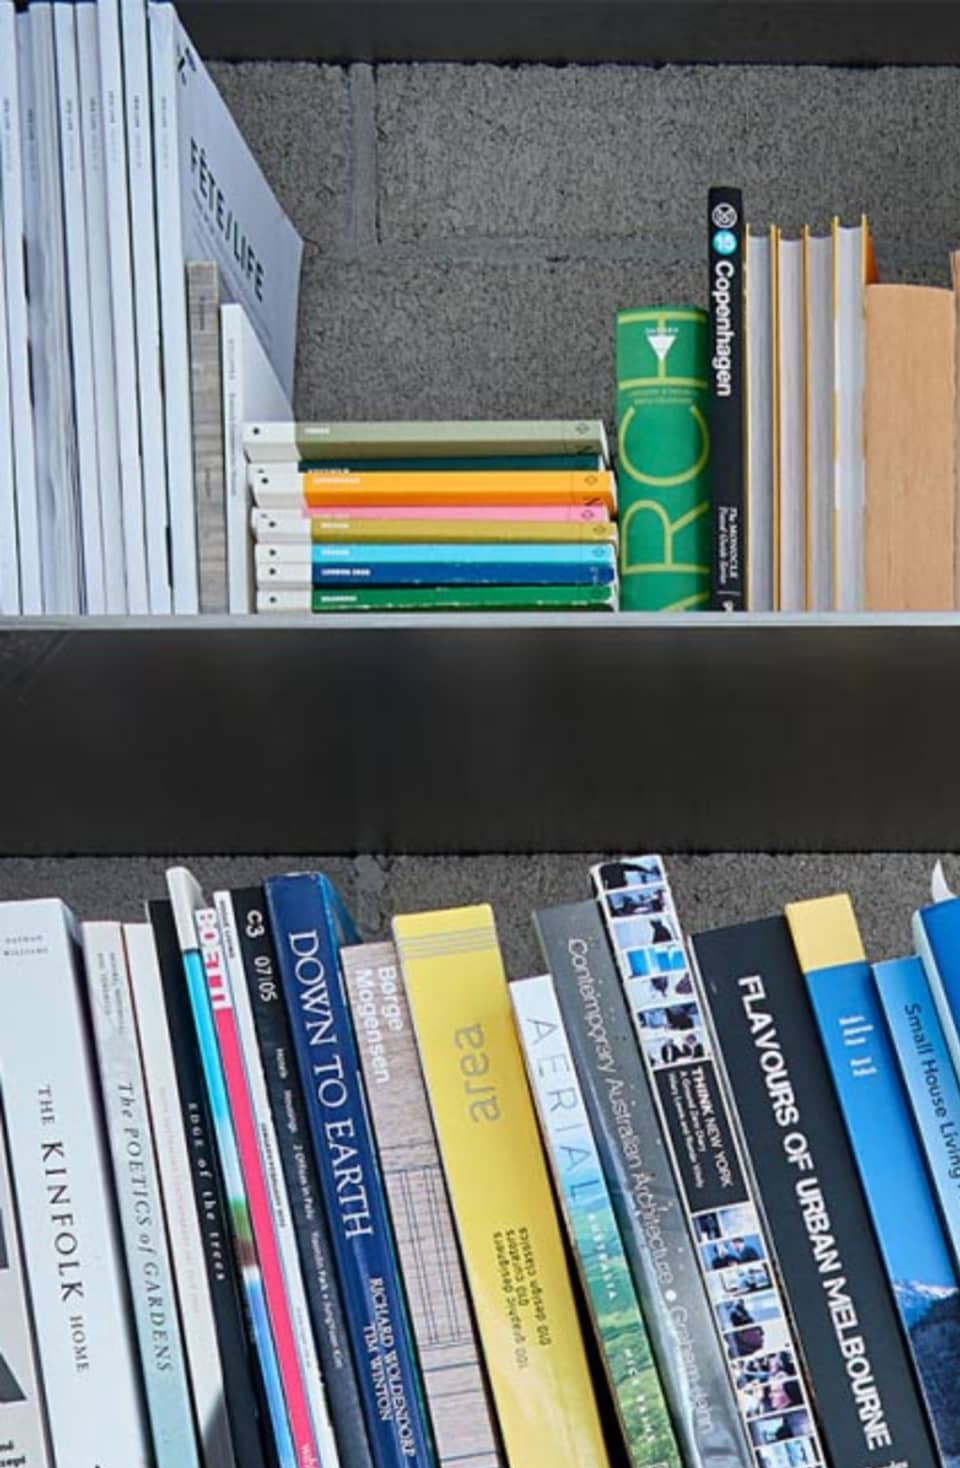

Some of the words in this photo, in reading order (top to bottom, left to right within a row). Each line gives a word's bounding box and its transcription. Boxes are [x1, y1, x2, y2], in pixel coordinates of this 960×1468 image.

[713, 259, 737, 397] Copenhagen
[728, 524, 739, 580] MONOCLE
[243, 907, 266, 939] C3
[284, 927, 338, 1050] DOWN
[372, 962, 407, 1033] Børge
[350, 966, 393, 1086] Mogensen
[735, 972, 802, 1129] FLAVOURS
[902, 999, 935, 1056] Small
[115, 1081, 137, 1122] The
[308, 1052, 350, 1113] TO
[451, 1021, 503, 1127] area
[690, 1064, 715, 1117] THINK
[918, 1056, 954, 1122] House
[37, 1085, 55, 1125] THE
[523, 1010, 602, 1202] AERIAL
[559, 934, 621, 1076] Contemporary
[603, 1074, 648, 1170] Australian
[629, 1168, 679, 1286] Architecture
[703, 1115, 724, 1151] NEW
[122, 1124, 154, 1230] POETICS
[197, 1156, 212, 1181] of
[321, 1116, 375, 1240] EARTH
[712, 1148, 734, 1189] YORK
[779, 1128, 814, 1175] OF
[39, 1138, 85, 1303] KINFOLK
[201, 1189, 218, 1221] the
[791, 1174, 843, 1275] URBAN
[135, 1233, 158, 1258] of
[207, 1230, 225, 1283] trees
[488, 1230, 517, 1296] designers
[502, 1227, 524, 1282] curators
[515, 1225, 538, 1281] classics
[141, 1260, 174, 1373] GARDENS
[502, 1295, 527, 1346] graphic
[527, 1280, 549, 1324] design
[67, 1314, 89, 1374] HOME
[361, 1321, 379, 1352] TIM
[821, 1273, 892, 1452] MELBOURNE
[367, 1352, 393, 1422] WINTON
[368, 1275, 395, 1348] RICHARD
[382, 1349, 416, 1459] WOLDENDORP
